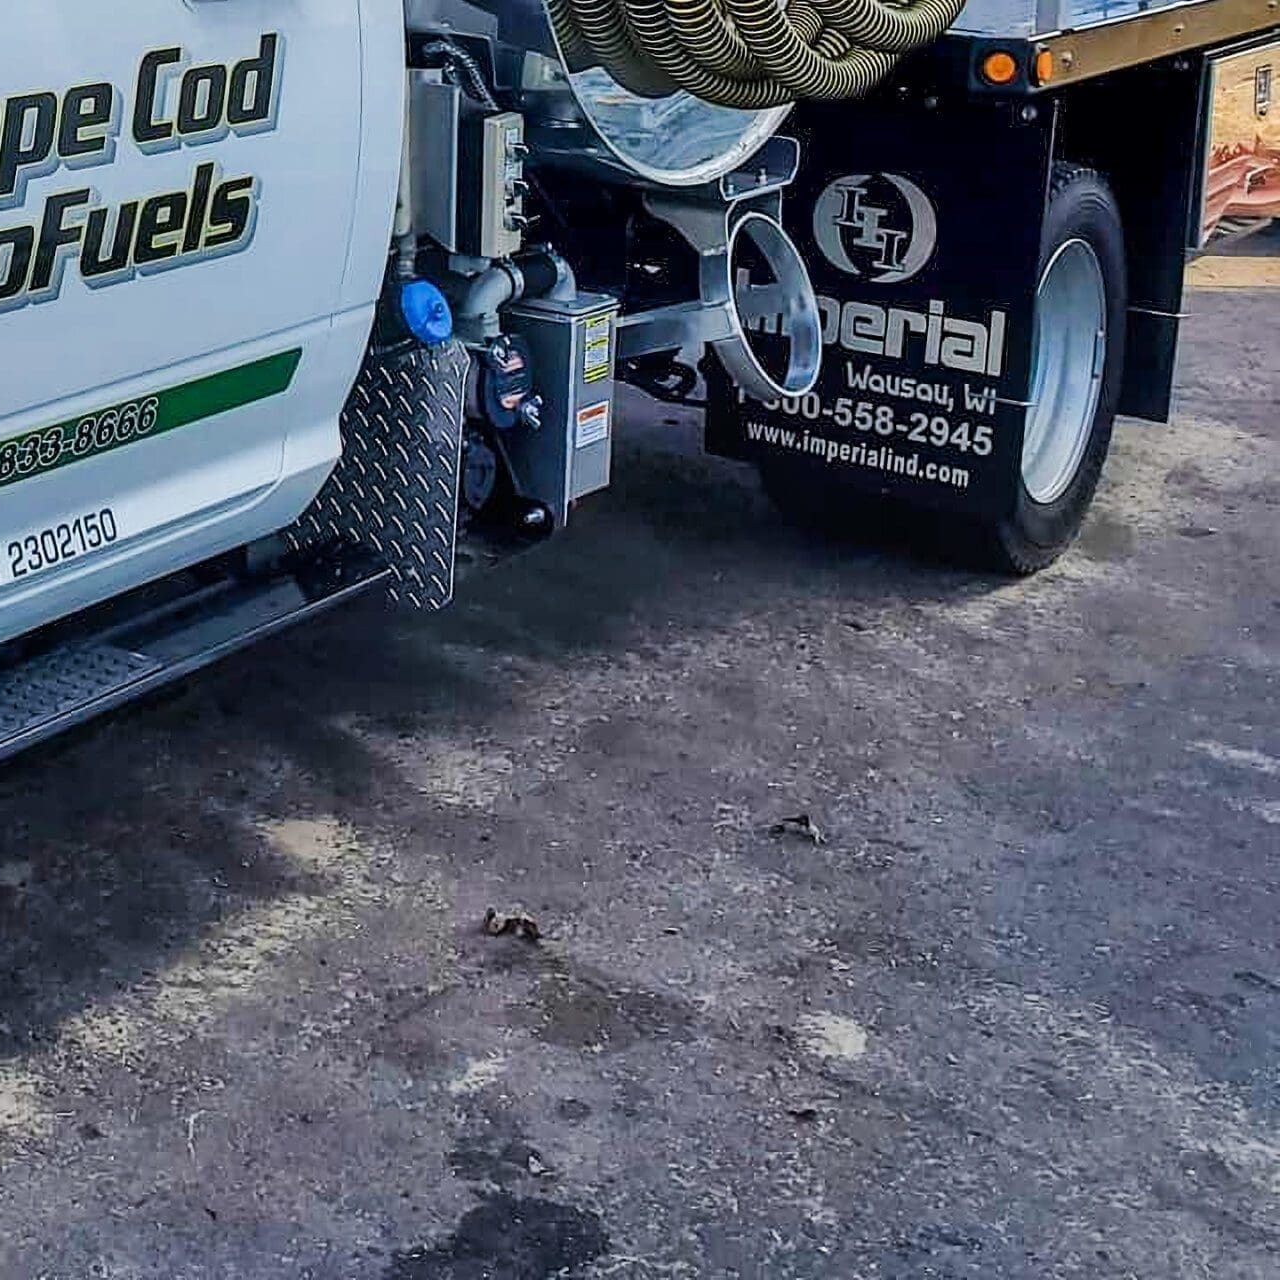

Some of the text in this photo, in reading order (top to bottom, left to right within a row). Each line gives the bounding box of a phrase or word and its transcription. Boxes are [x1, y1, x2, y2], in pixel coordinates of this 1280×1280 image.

[131, 31, 281, 147] Cod
[736, 267, 1006, 377] perial
[846, 361, 997, 415] Wausau, WI
[746, 420, 969, 488] www.imperialind.com
[6, 508, 118, 578] 2302150
